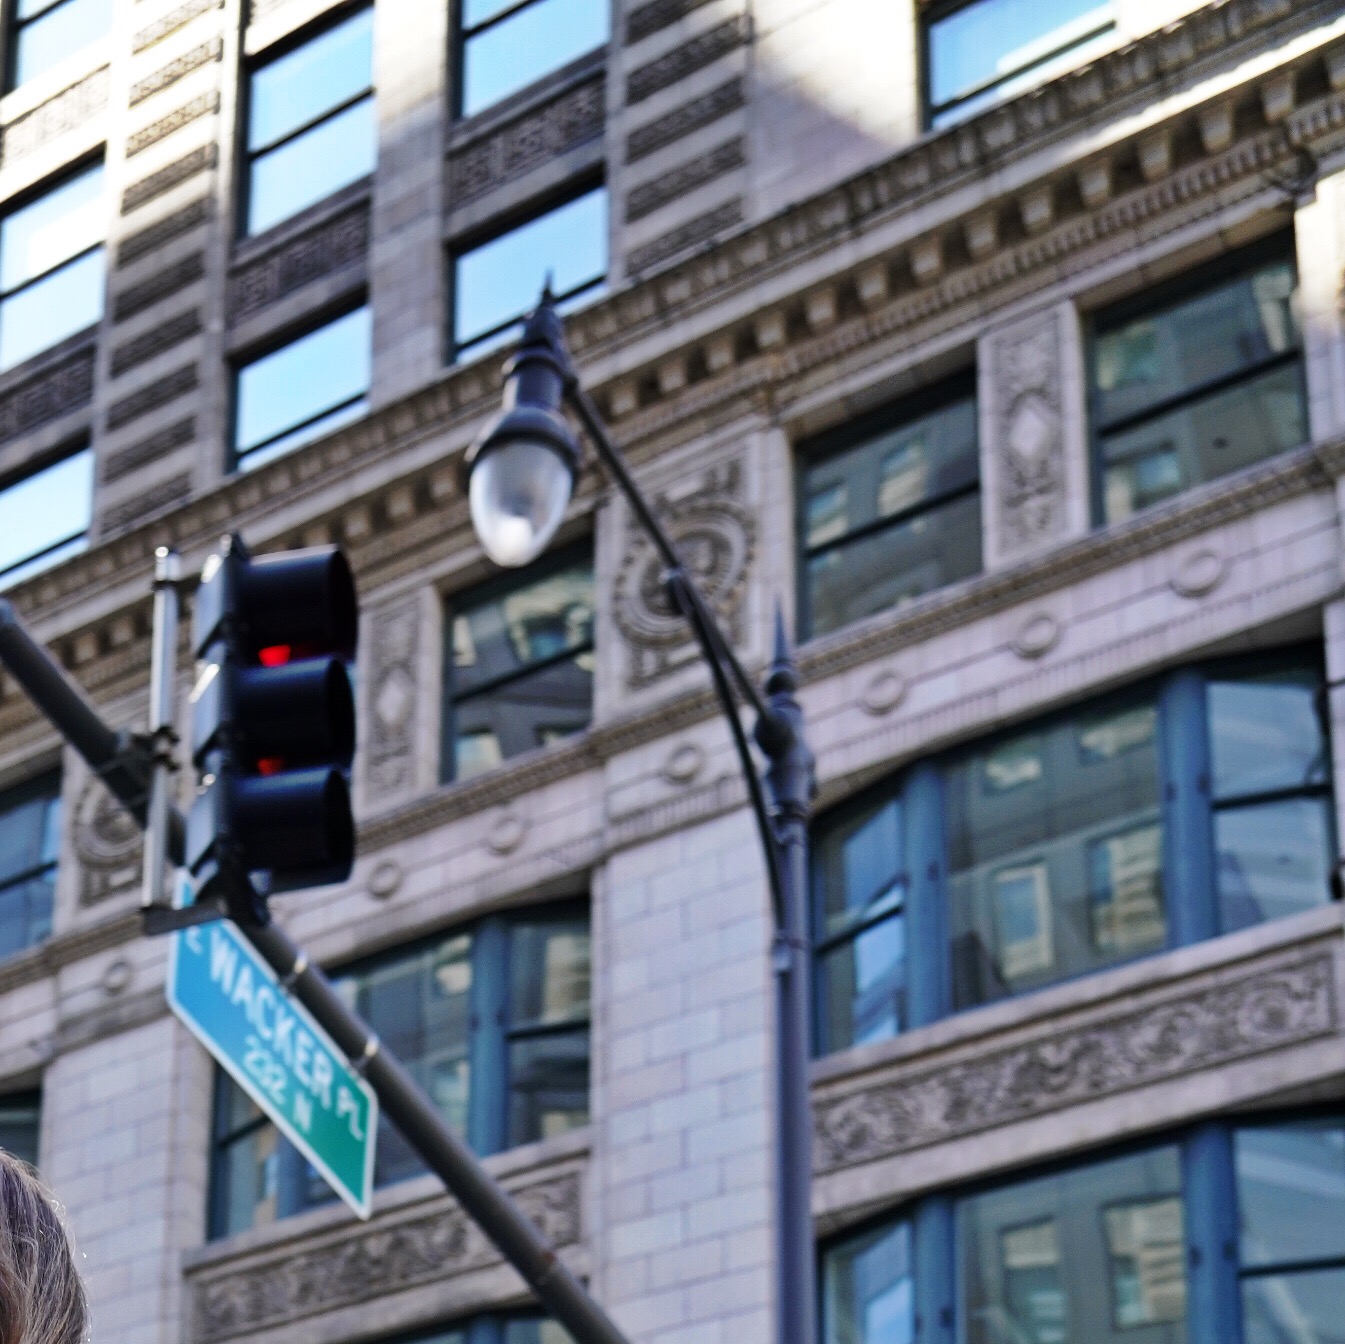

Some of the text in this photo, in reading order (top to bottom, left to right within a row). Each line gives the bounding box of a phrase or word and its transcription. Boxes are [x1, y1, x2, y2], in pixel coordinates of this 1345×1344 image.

[209, 928, 334, 1109] WACKER
[336, 1084, 364, 1142] PL
[293, 1091, 315, 1134] N
